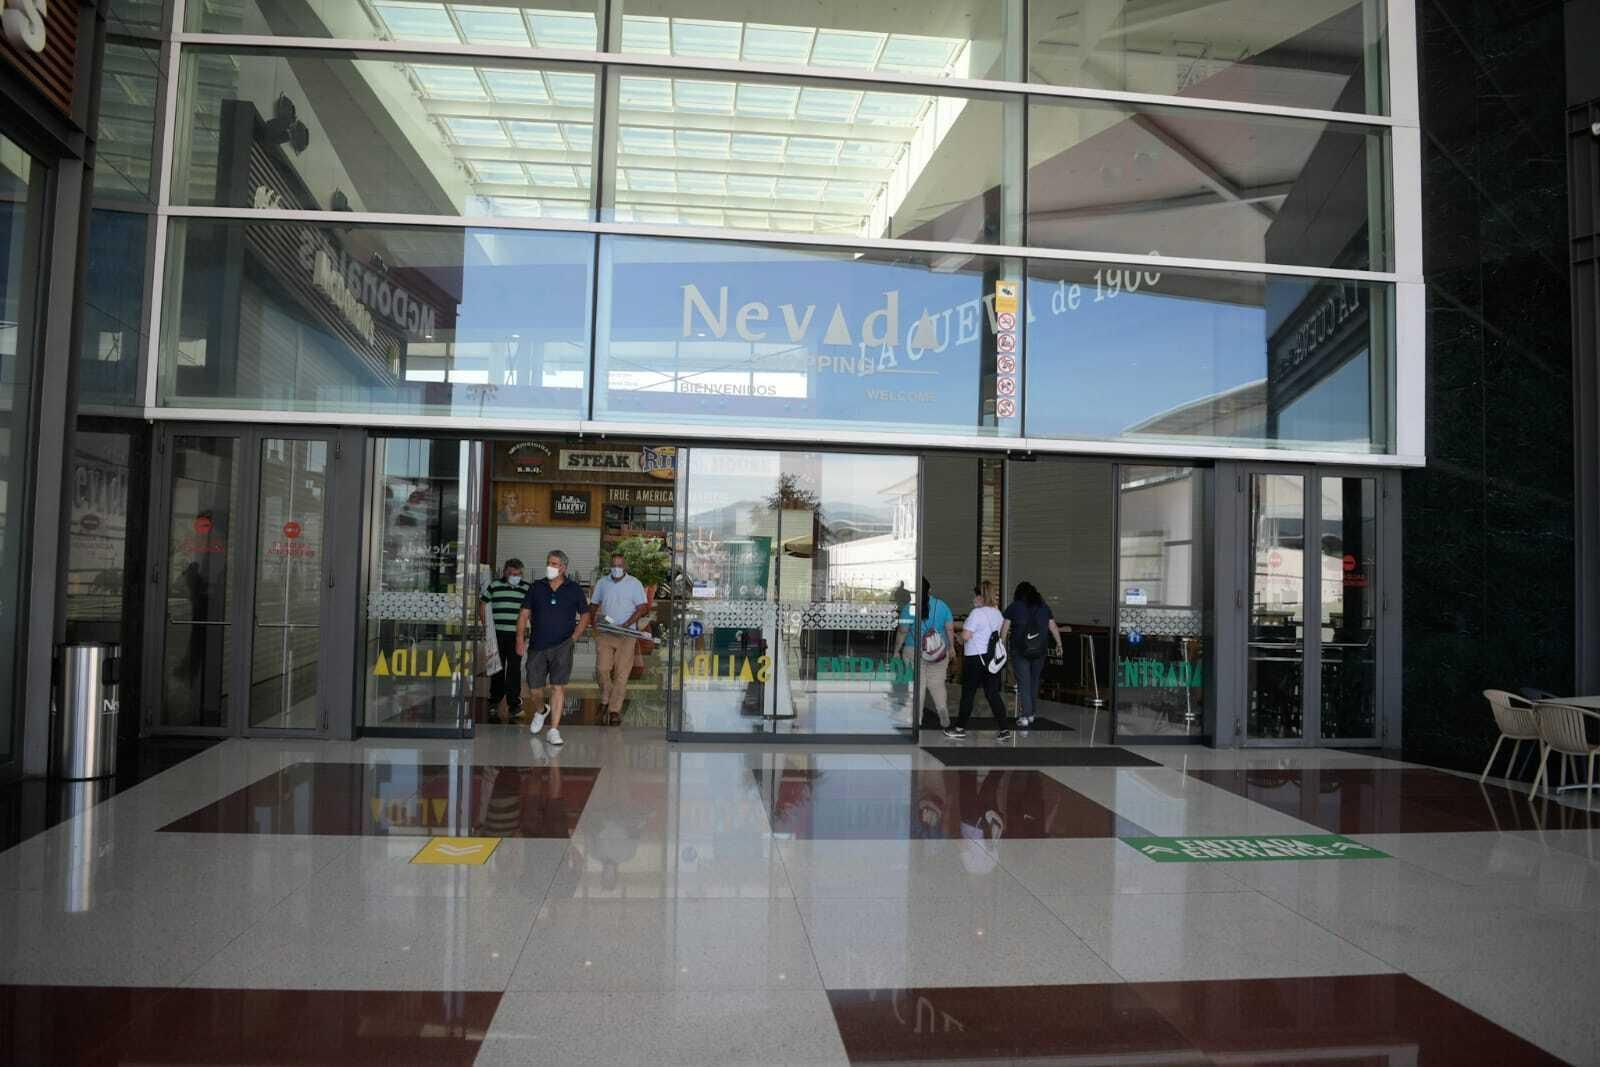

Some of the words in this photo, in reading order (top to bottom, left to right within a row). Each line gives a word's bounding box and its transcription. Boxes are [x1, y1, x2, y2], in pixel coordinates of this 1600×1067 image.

[1052, 280, 1081, 315] de
[680, 284, 939, 350] Nevada
[681, 382, 777, 396] BIENVENIDOS
[866, 389, 937, 402] WELCOME
[568, 453, 631, 468] STEAK
[609, 488, 630, 502] TRUE
[1175, 839, 1314, 850] ENTRADA
